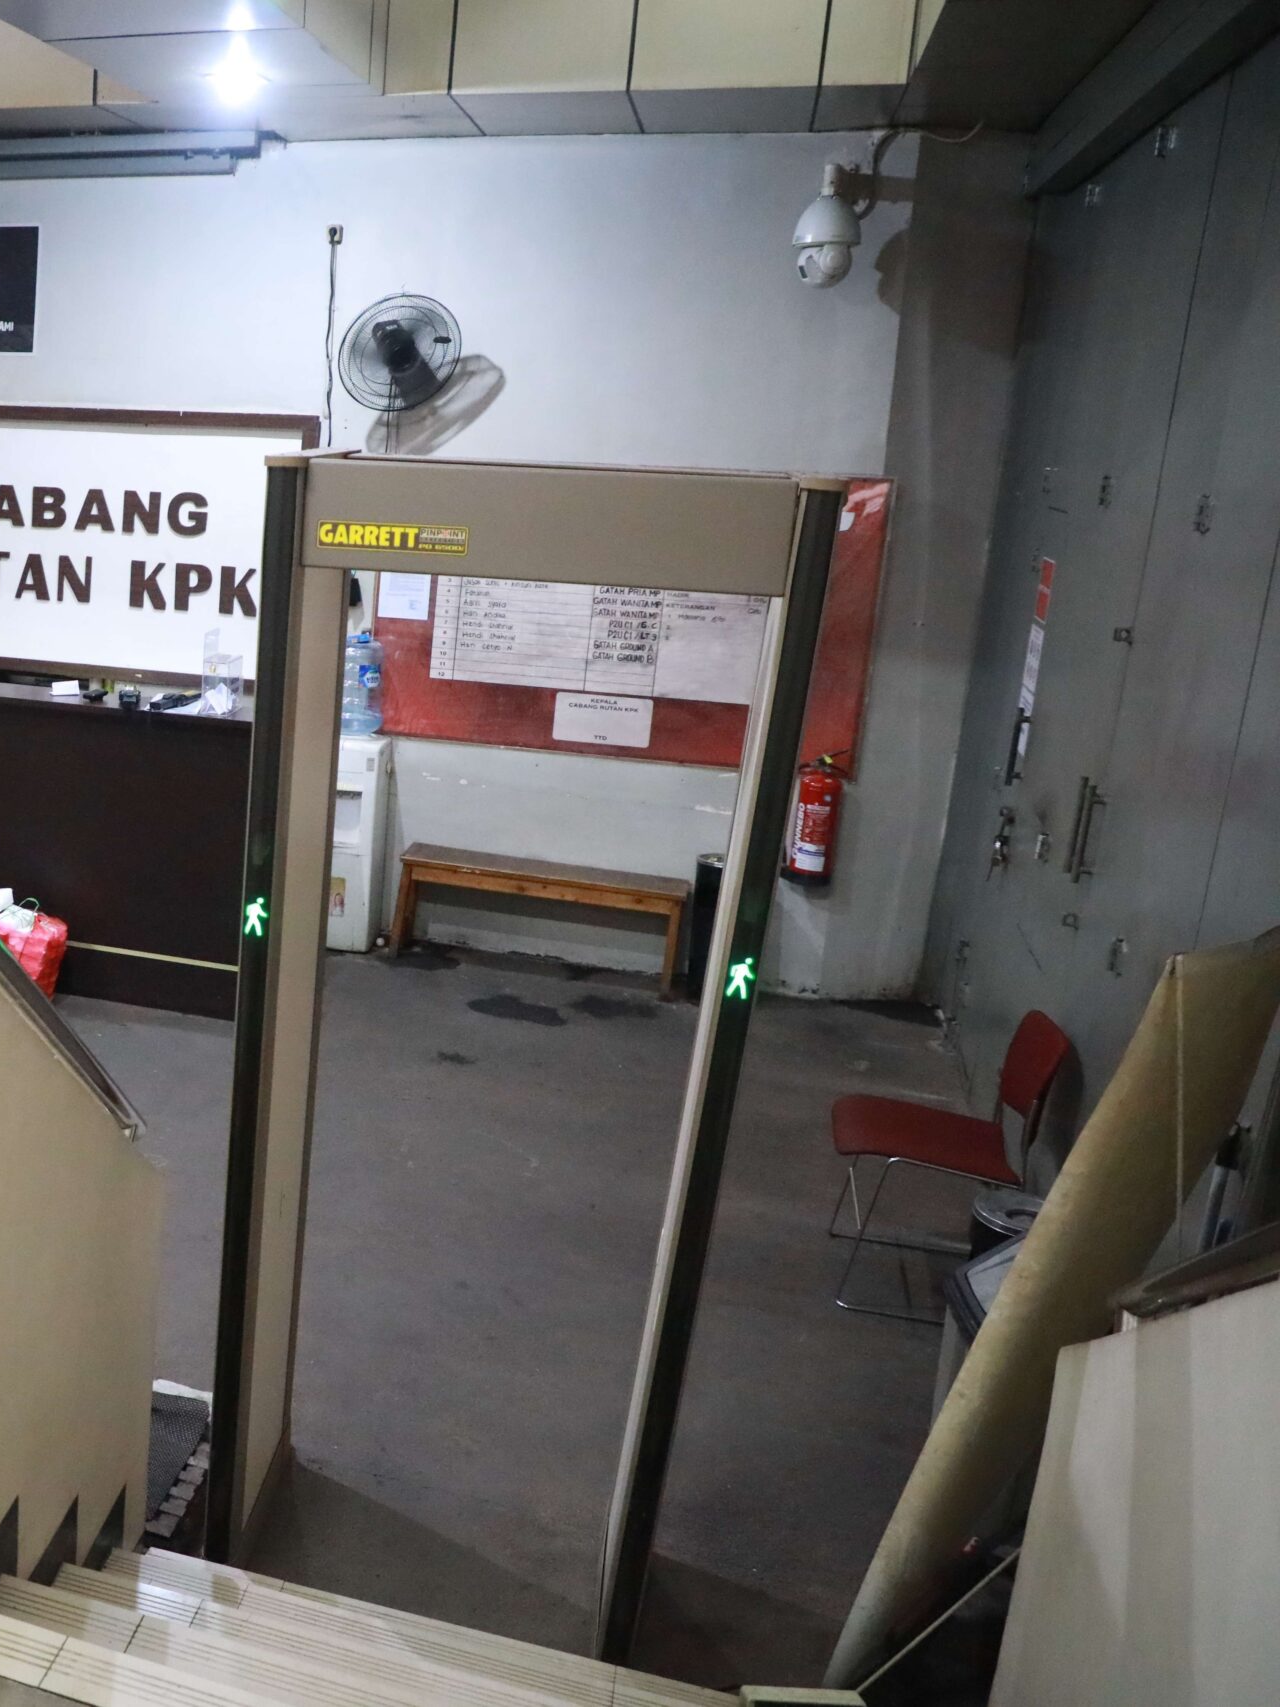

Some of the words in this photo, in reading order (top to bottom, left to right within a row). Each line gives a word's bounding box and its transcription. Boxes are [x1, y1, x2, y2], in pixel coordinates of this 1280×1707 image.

[320, 523, 418, 548] GARRETT
[129, 560, 257, 618] KPK
[627, 589, 648, 597] PRIA
[619, 610, 648, 618] WANITA
[647, 644, 654, 652] A
[646, 654, 654, 664] B
[568, 702, 598, 710] CABANG
